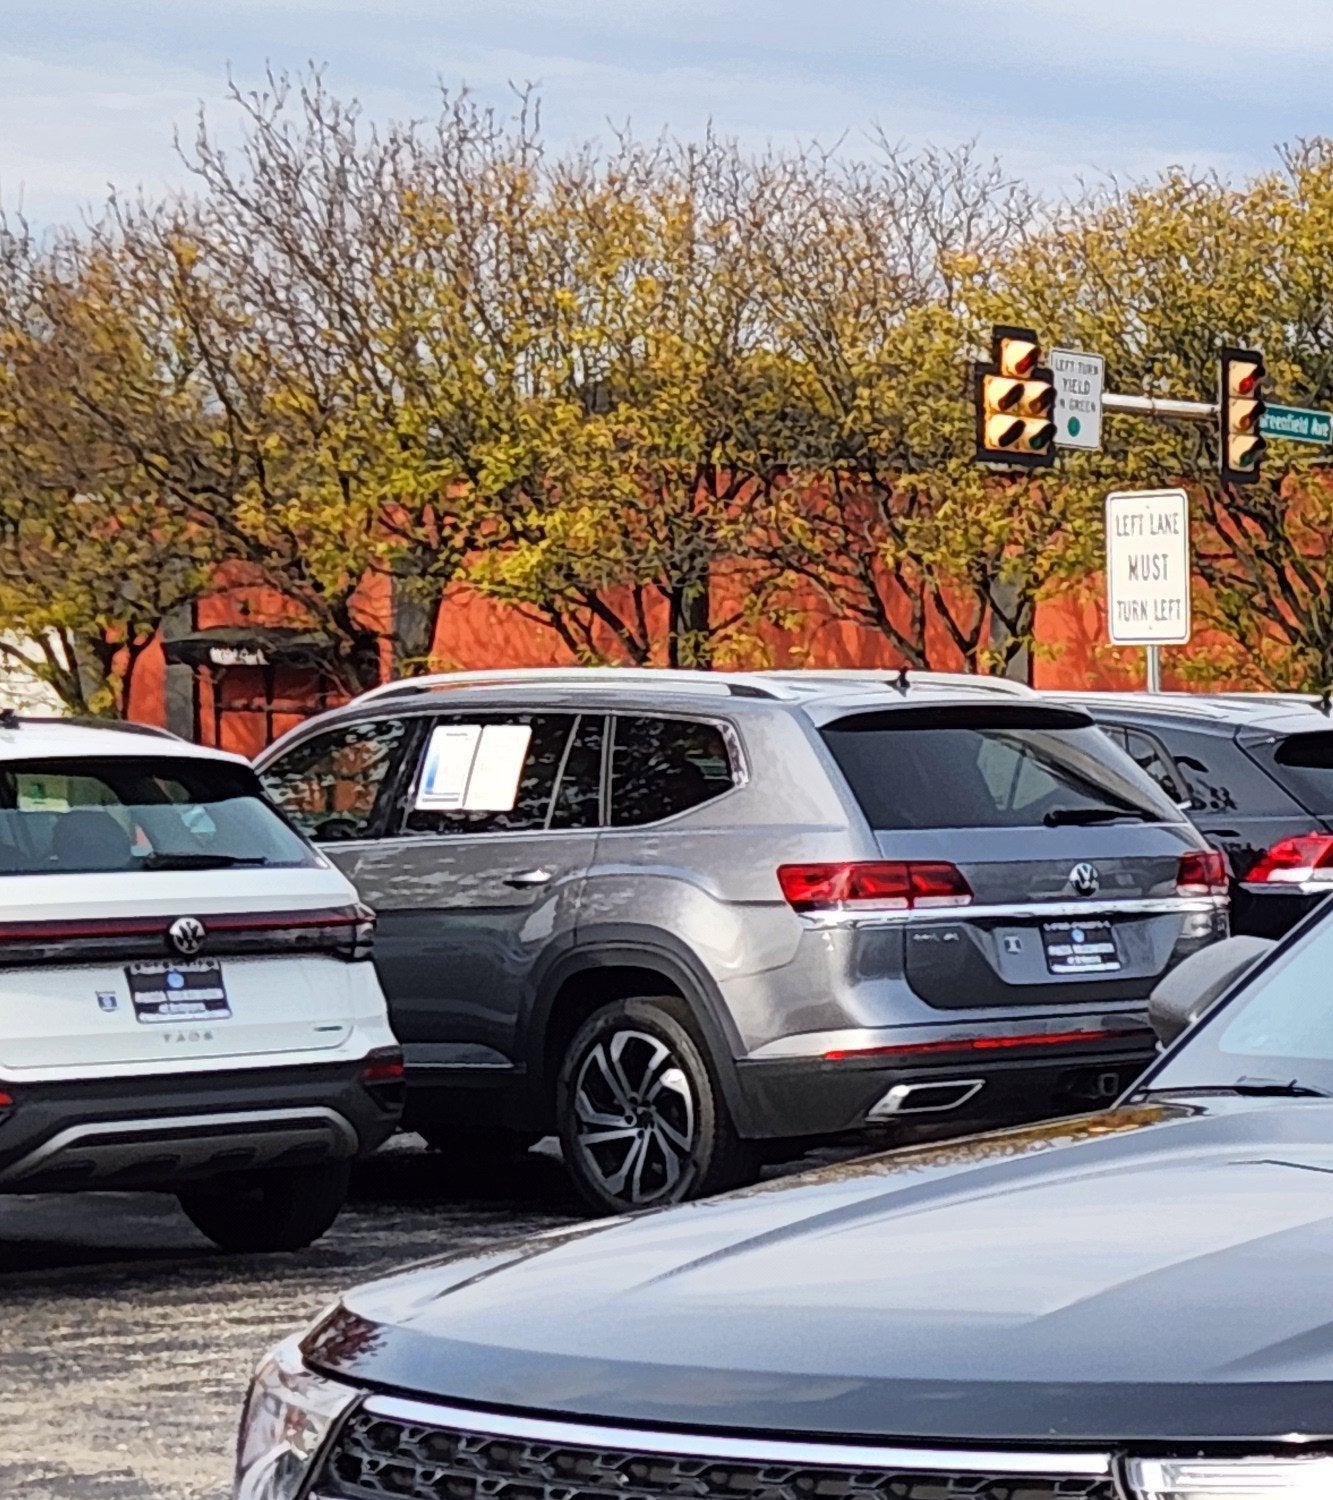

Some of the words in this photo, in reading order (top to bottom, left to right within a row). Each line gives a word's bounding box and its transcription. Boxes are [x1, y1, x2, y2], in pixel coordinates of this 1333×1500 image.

[1062, 378, 1091, 396] YIELD
[1115, 513, 1144, 537] LEFT
[1149, 511, 1180, 536] LANE
[1127, 552, 1169, 582] MUST
[1116, 599, 1148, 622] TURN
[1153, 598, 1181, 621] LEFT
